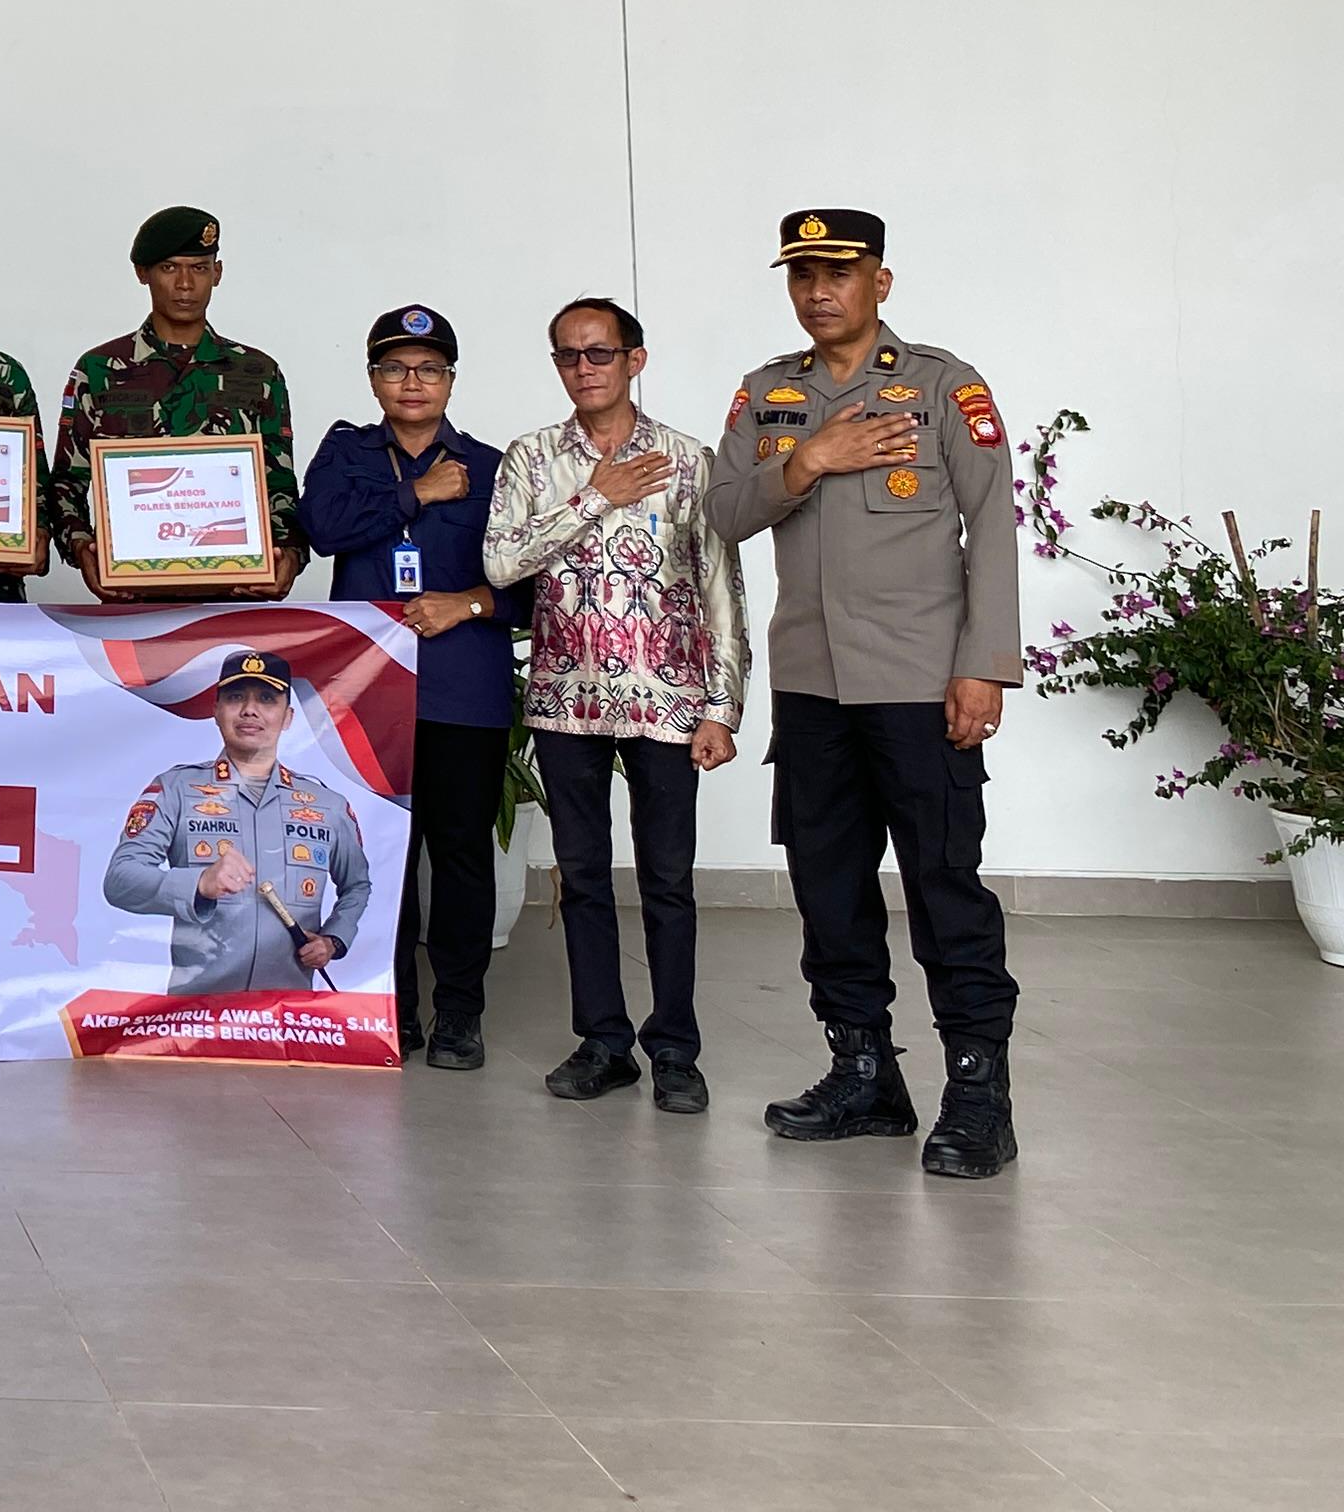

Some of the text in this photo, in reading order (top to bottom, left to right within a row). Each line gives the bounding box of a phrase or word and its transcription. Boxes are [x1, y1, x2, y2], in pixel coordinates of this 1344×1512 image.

[167, 489, 206, 498] BANSOS
[134, 500, 241, 512] POLRES BENGKAYANG
[188, 819, 239, 833] SYAHRUL
[286, 825, 331, 843] POLRI
[219, 1009, 279, 1028] AWAB,
[284, 1012, 343, 1030] S.Sos.,
[347, 1018, 393, 1032] S.I.K.
[123, 1024, 346, 1046] KAPOLRES BENGKAYANG
